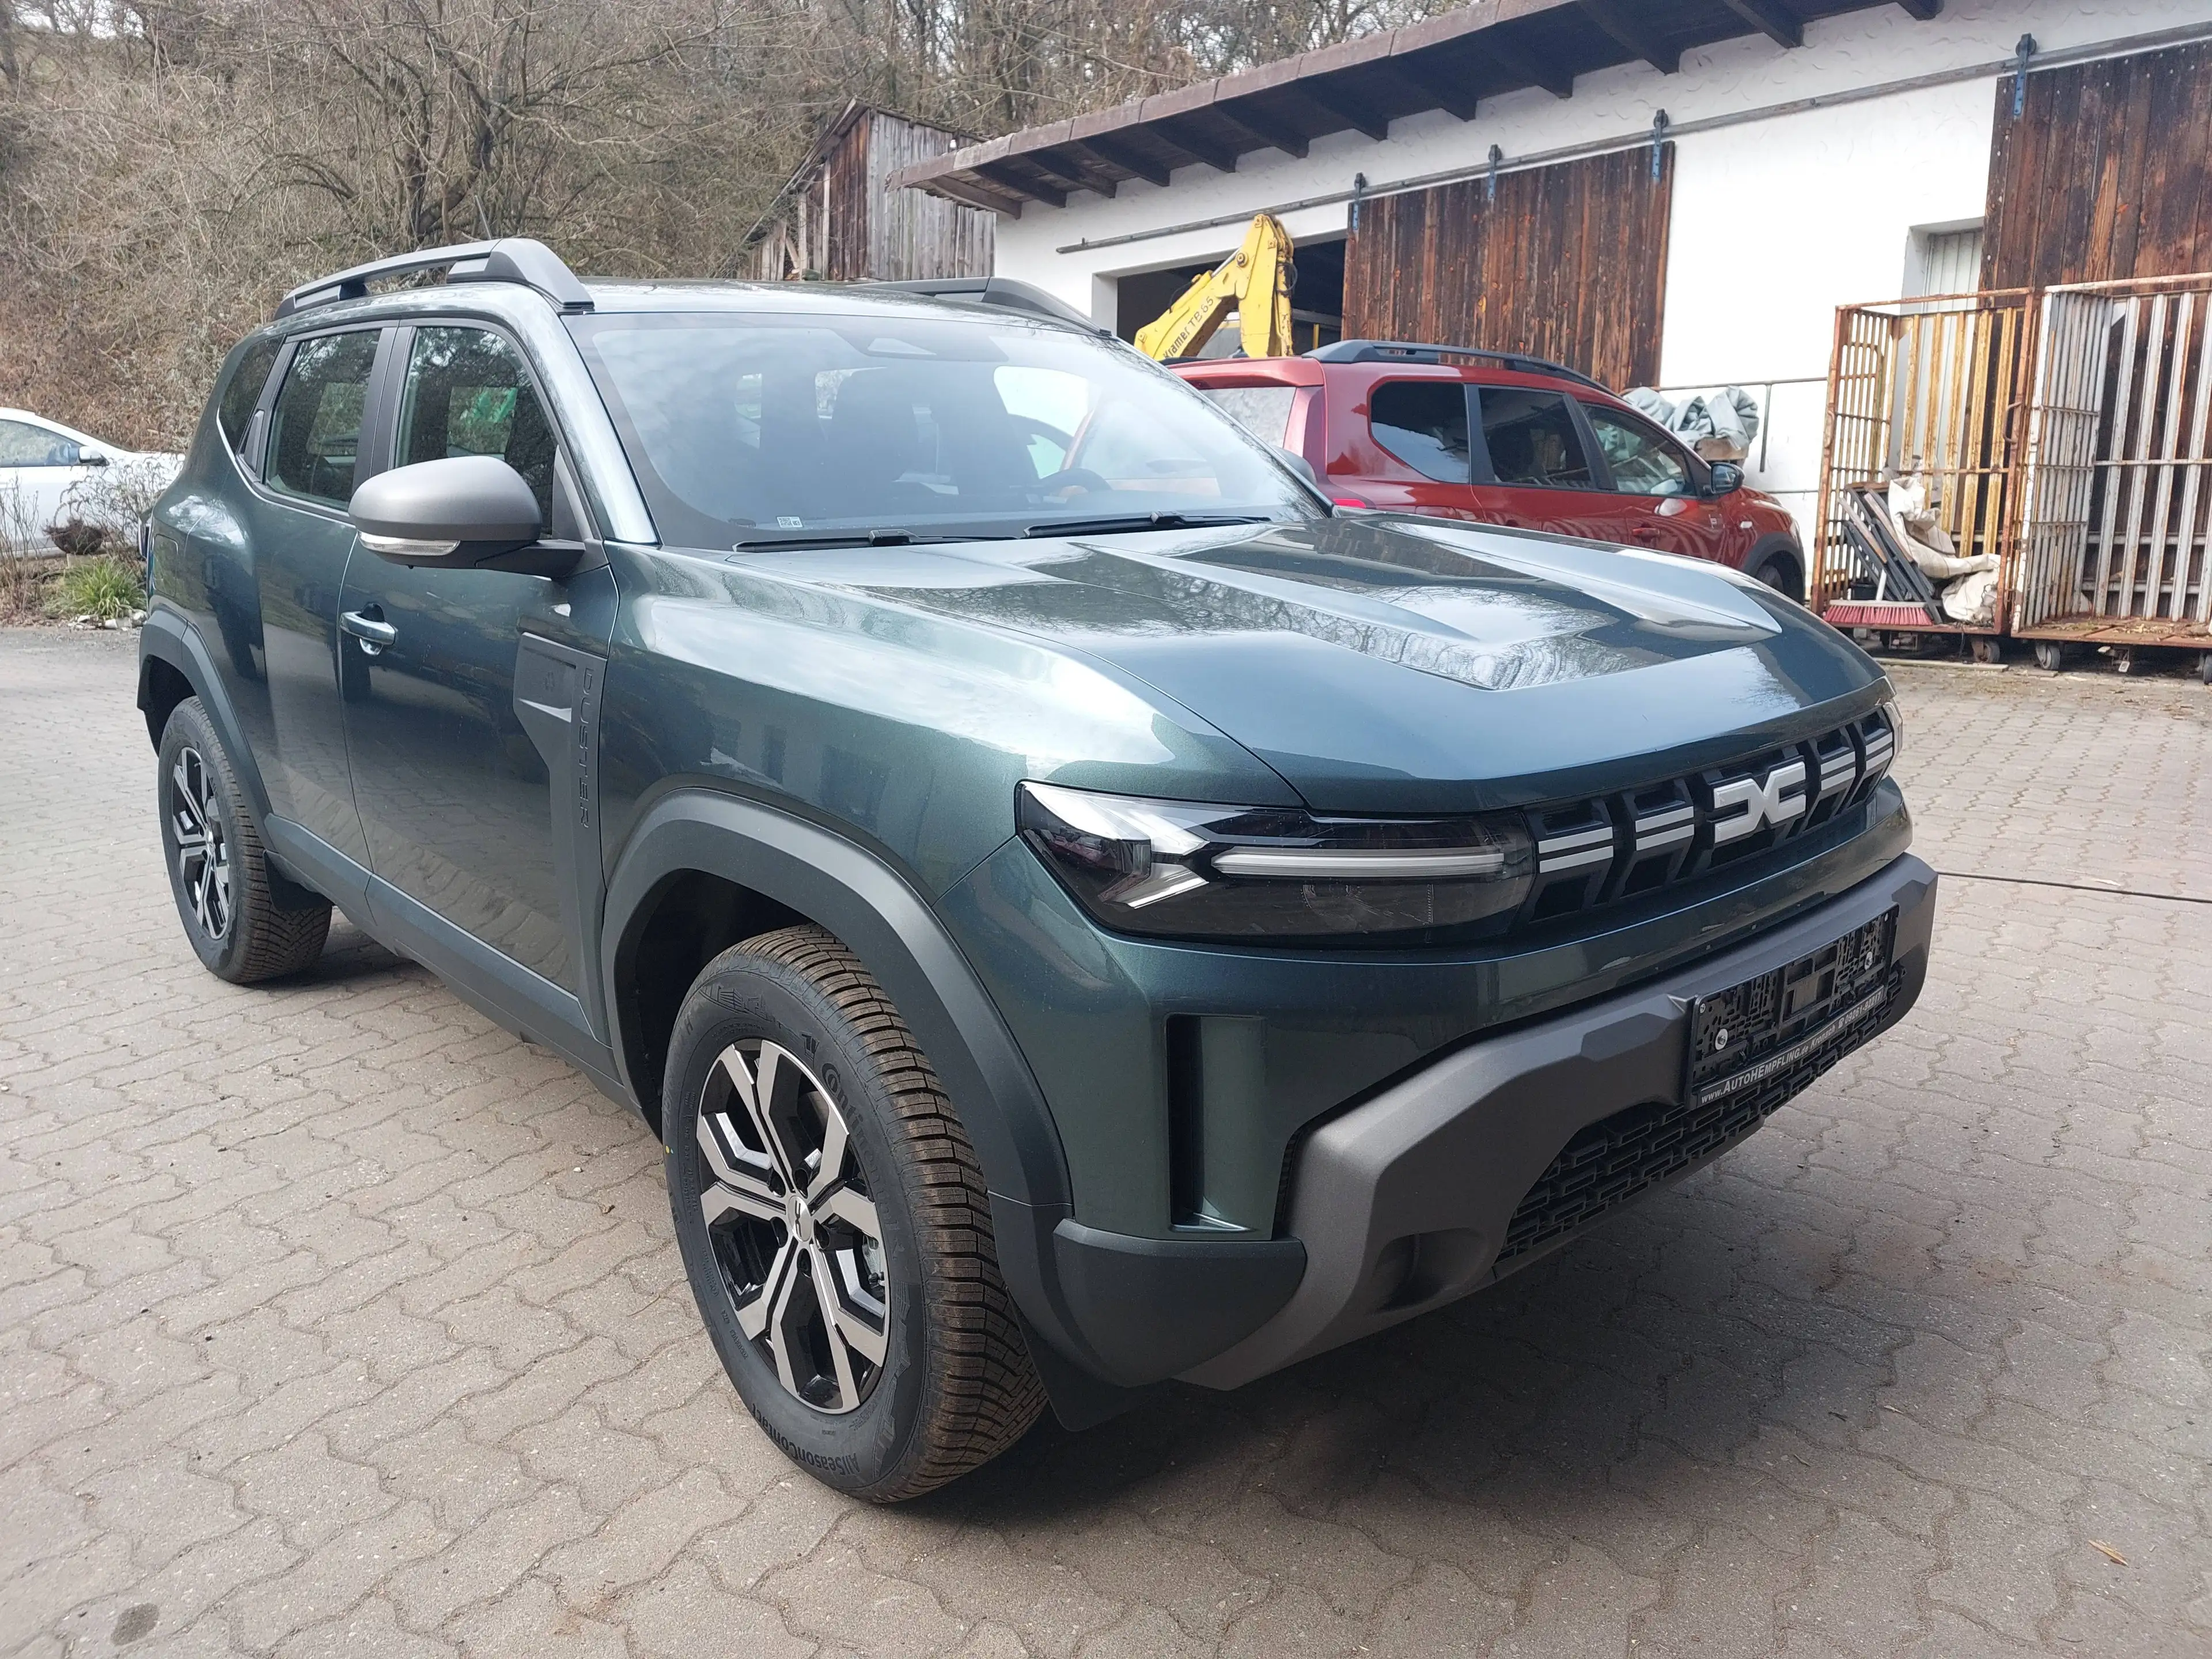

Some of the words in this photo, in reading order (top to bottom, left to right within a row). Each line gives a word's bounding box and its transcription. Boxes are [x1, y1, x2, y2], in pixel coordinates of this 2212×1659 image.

[1162, 326, 1190, 358] Kramer
[1188, 311, 1202, 327] TB
[579, 667, 594, 828] DUSTER
[1810, 1024, 1836, 1048] Kronach
[752, 1403, 861, 1476] AllSeasonContact
